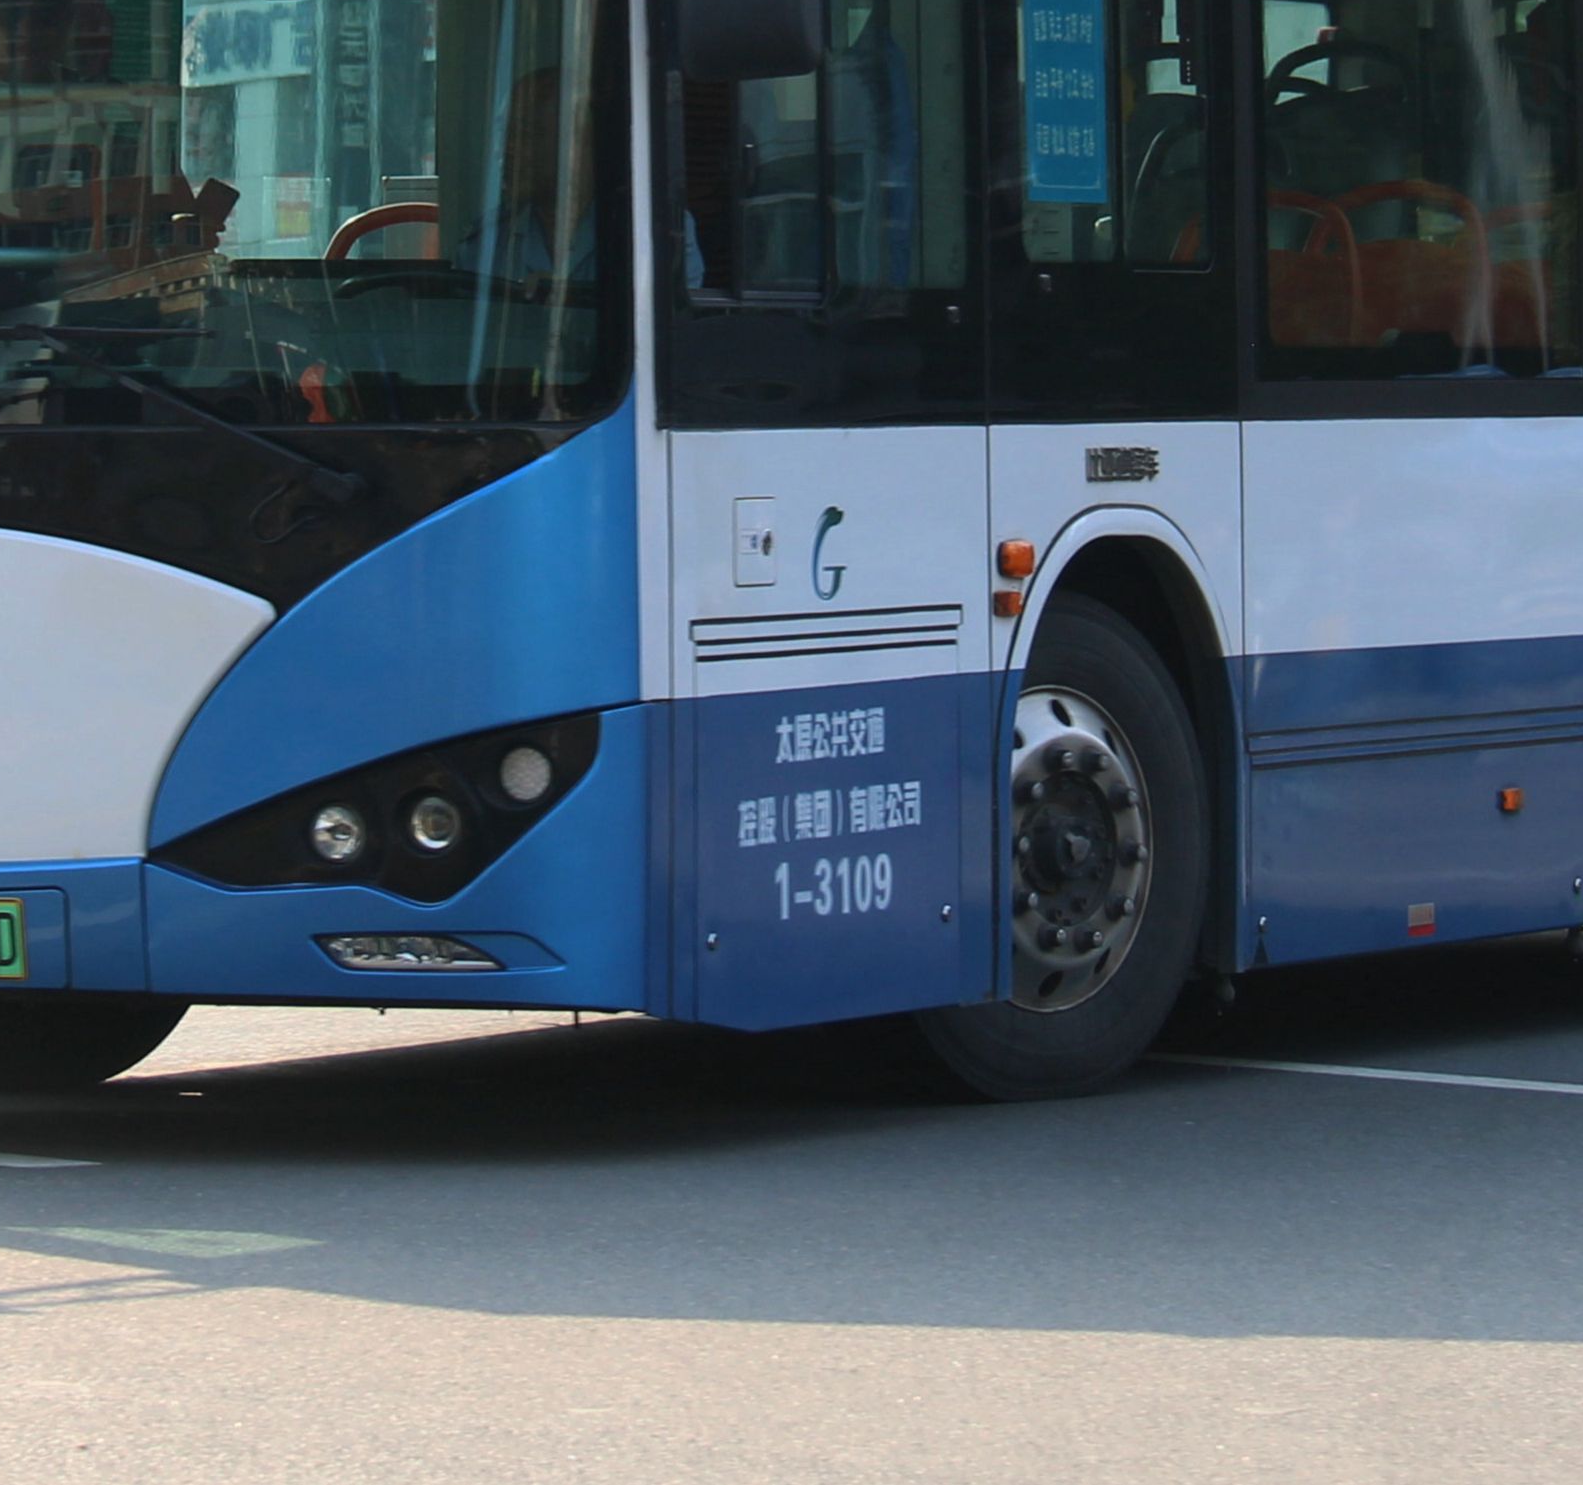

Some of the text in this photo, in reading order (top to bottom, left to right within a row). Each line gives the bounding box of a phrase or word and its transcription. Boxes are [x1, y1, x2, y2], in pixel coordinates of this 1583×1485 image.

[775, 706, 885, 764] 太原公共交通
[774, 853, 893, 920] 1-3109
